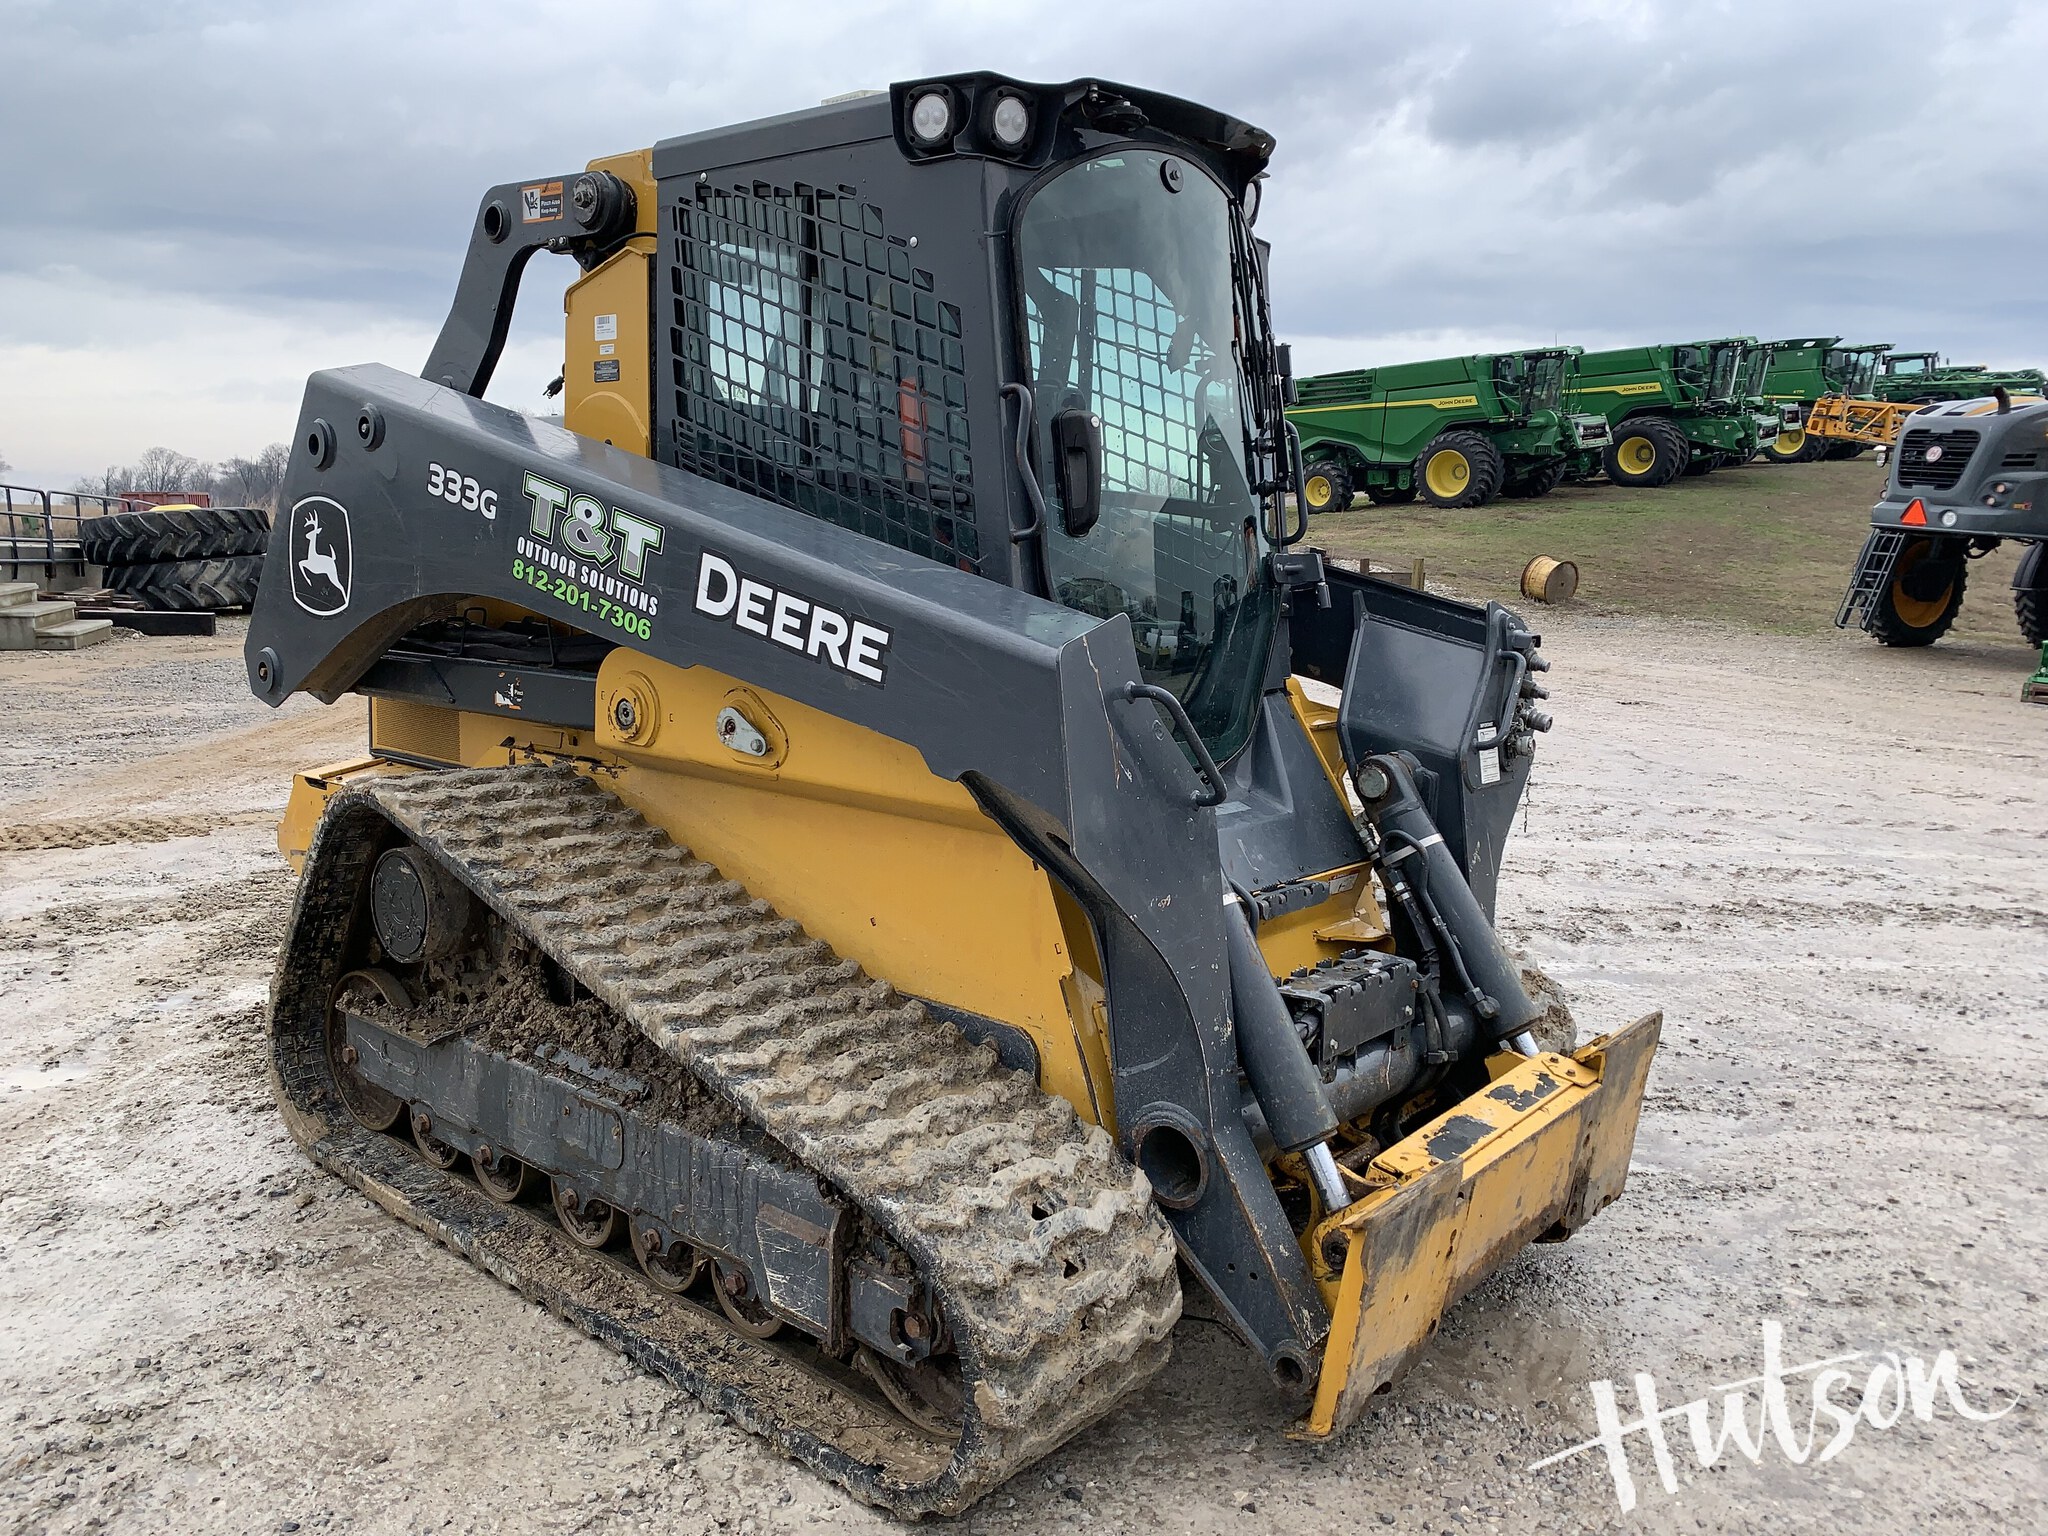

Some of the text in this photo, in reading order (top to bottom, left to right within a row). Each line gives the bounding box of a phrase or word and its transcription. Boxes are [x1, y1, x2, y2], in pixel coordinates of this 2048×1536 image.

[427, 463, 498, 520] 333G
[522, 469, 666, 586] T&T
[511, 558, 652, 640] 812-201-7306
[517, 536, 659, 616] OUTDOOR SOLUTIONS
[695, 552, 889, 683] DEERE
